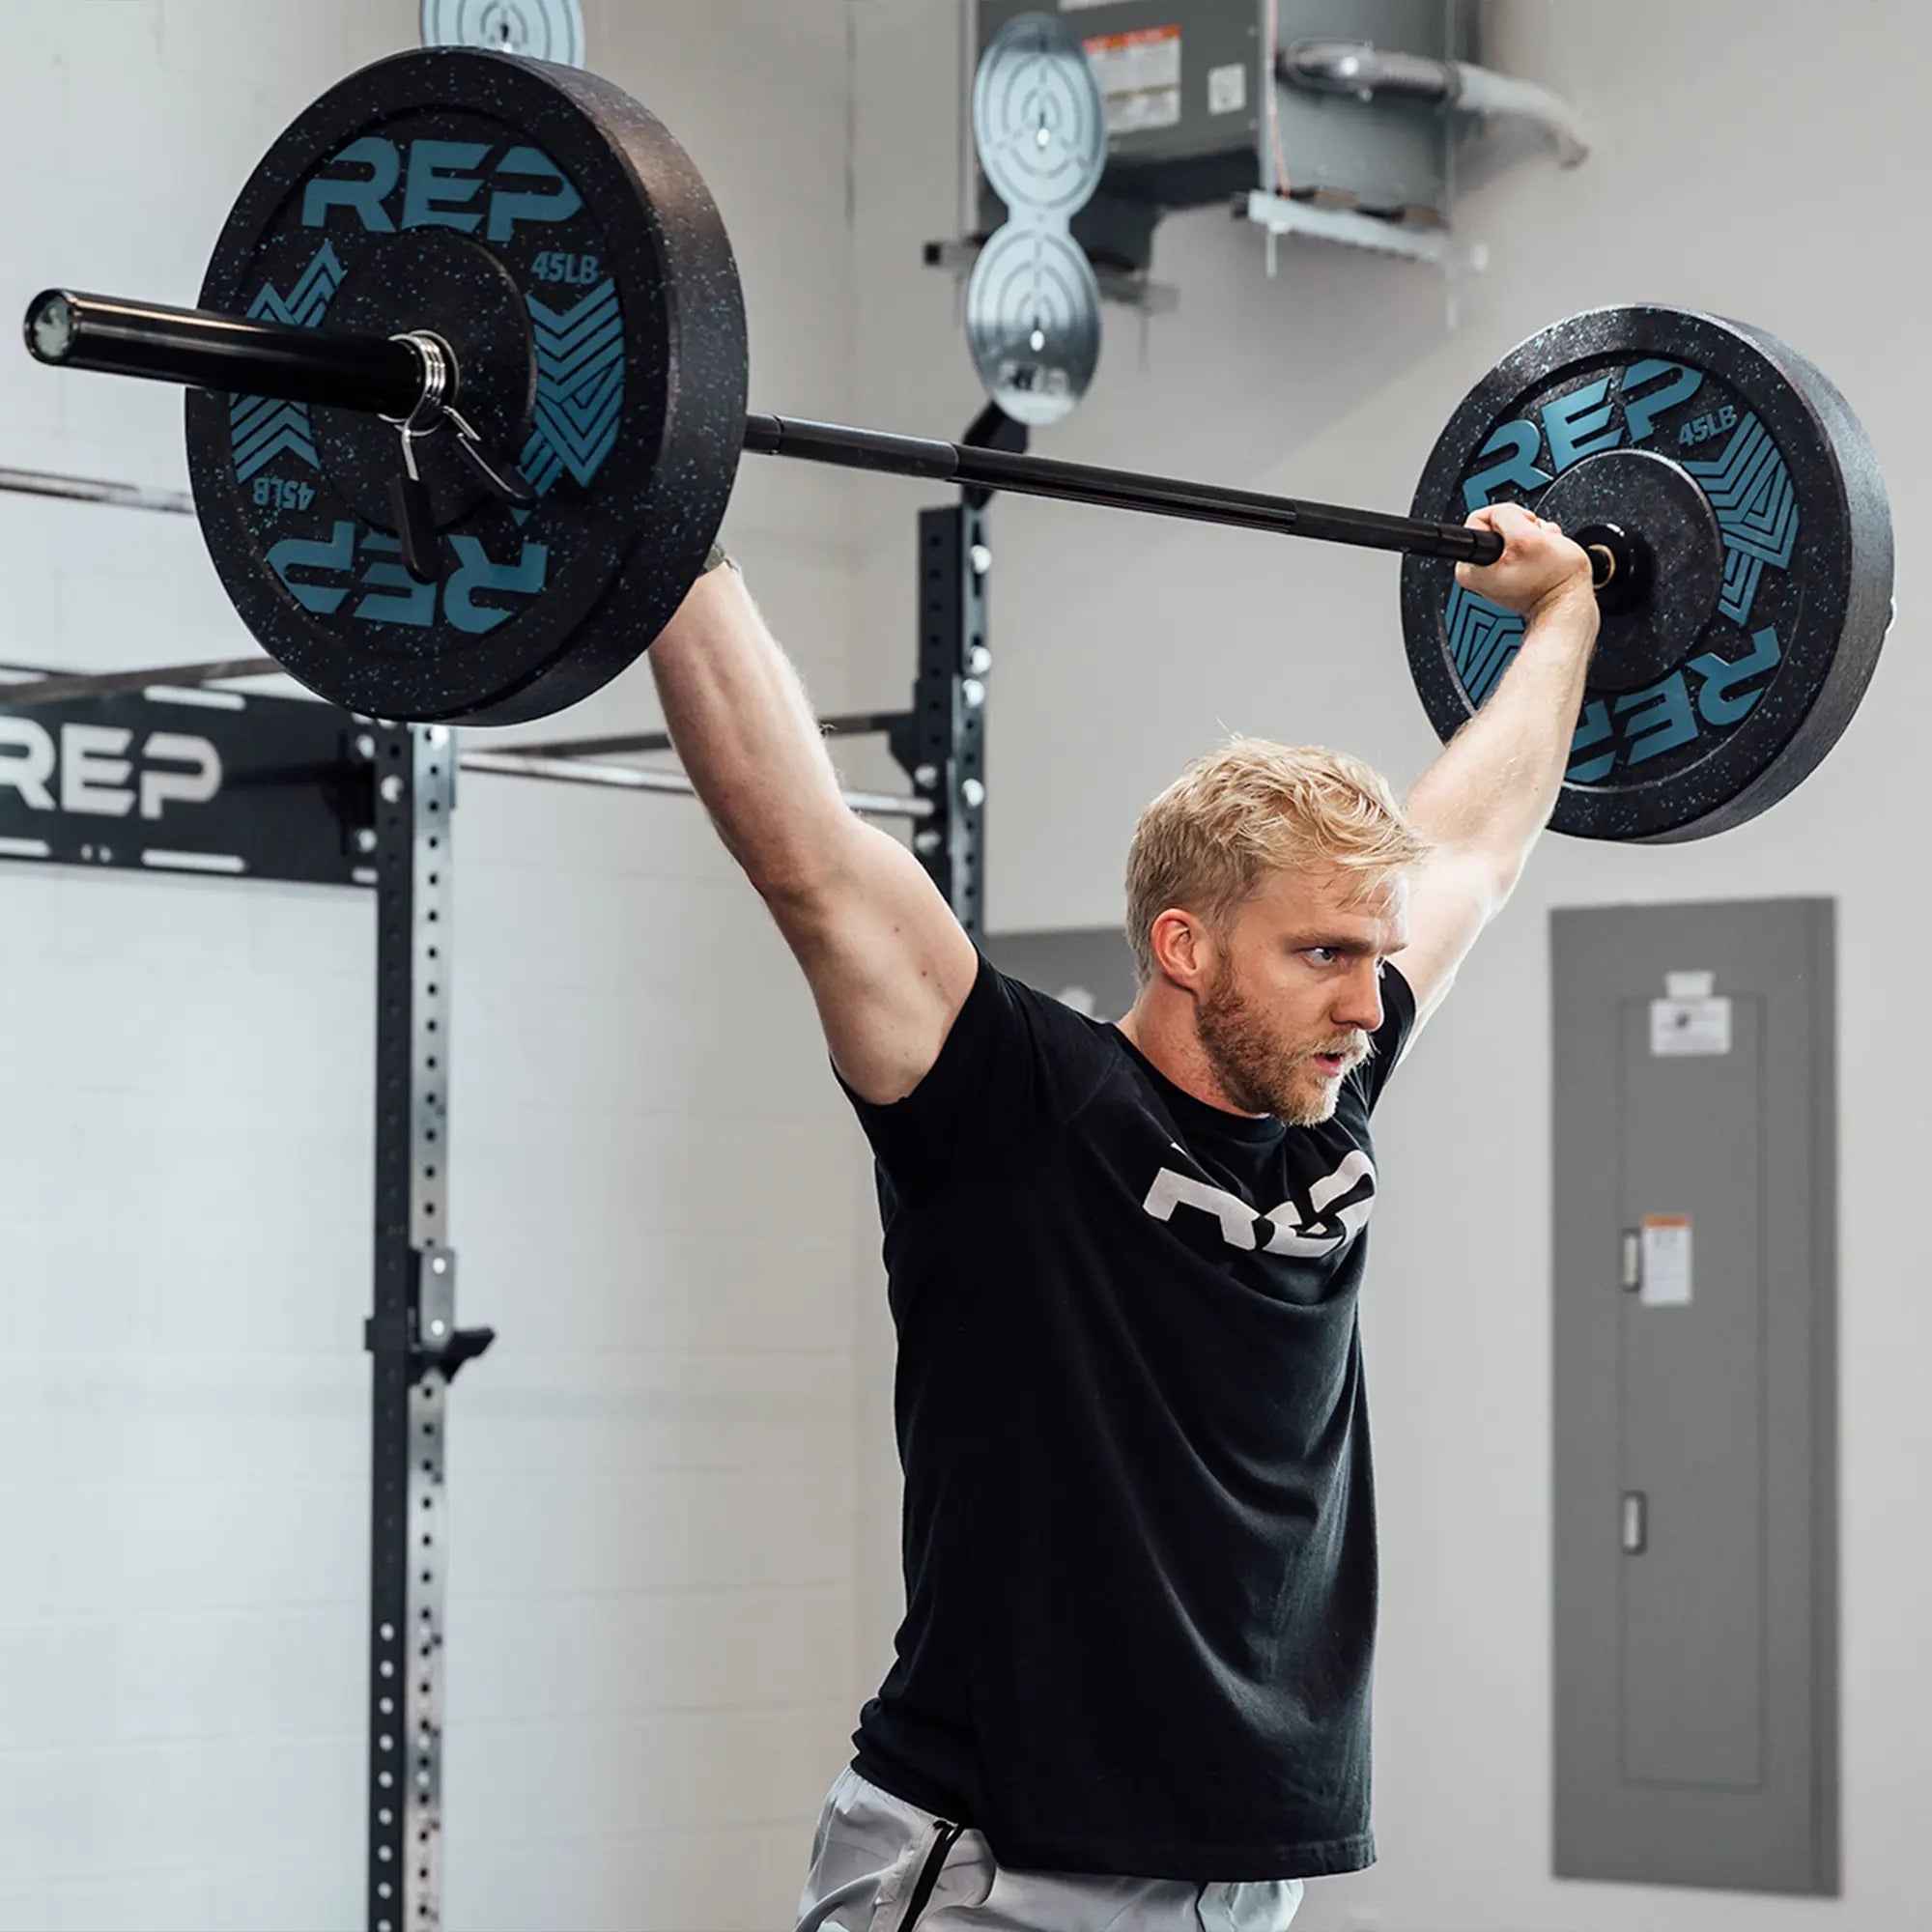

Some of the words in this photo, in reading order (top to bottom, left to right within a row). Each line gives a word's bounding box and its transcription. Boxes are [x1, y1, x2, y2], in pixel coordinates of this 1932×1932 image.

[301, 136, 583, 242] REP
[530, 251, 600, 285] 45LB
[1462, 358, 1706, 514] REP
[1678, 405, 1738, 447] 45LB
[252, 476, 316, 511] 45LB
[264, 521, 549, 634] REP
[0, 715, 223, 820] REP
